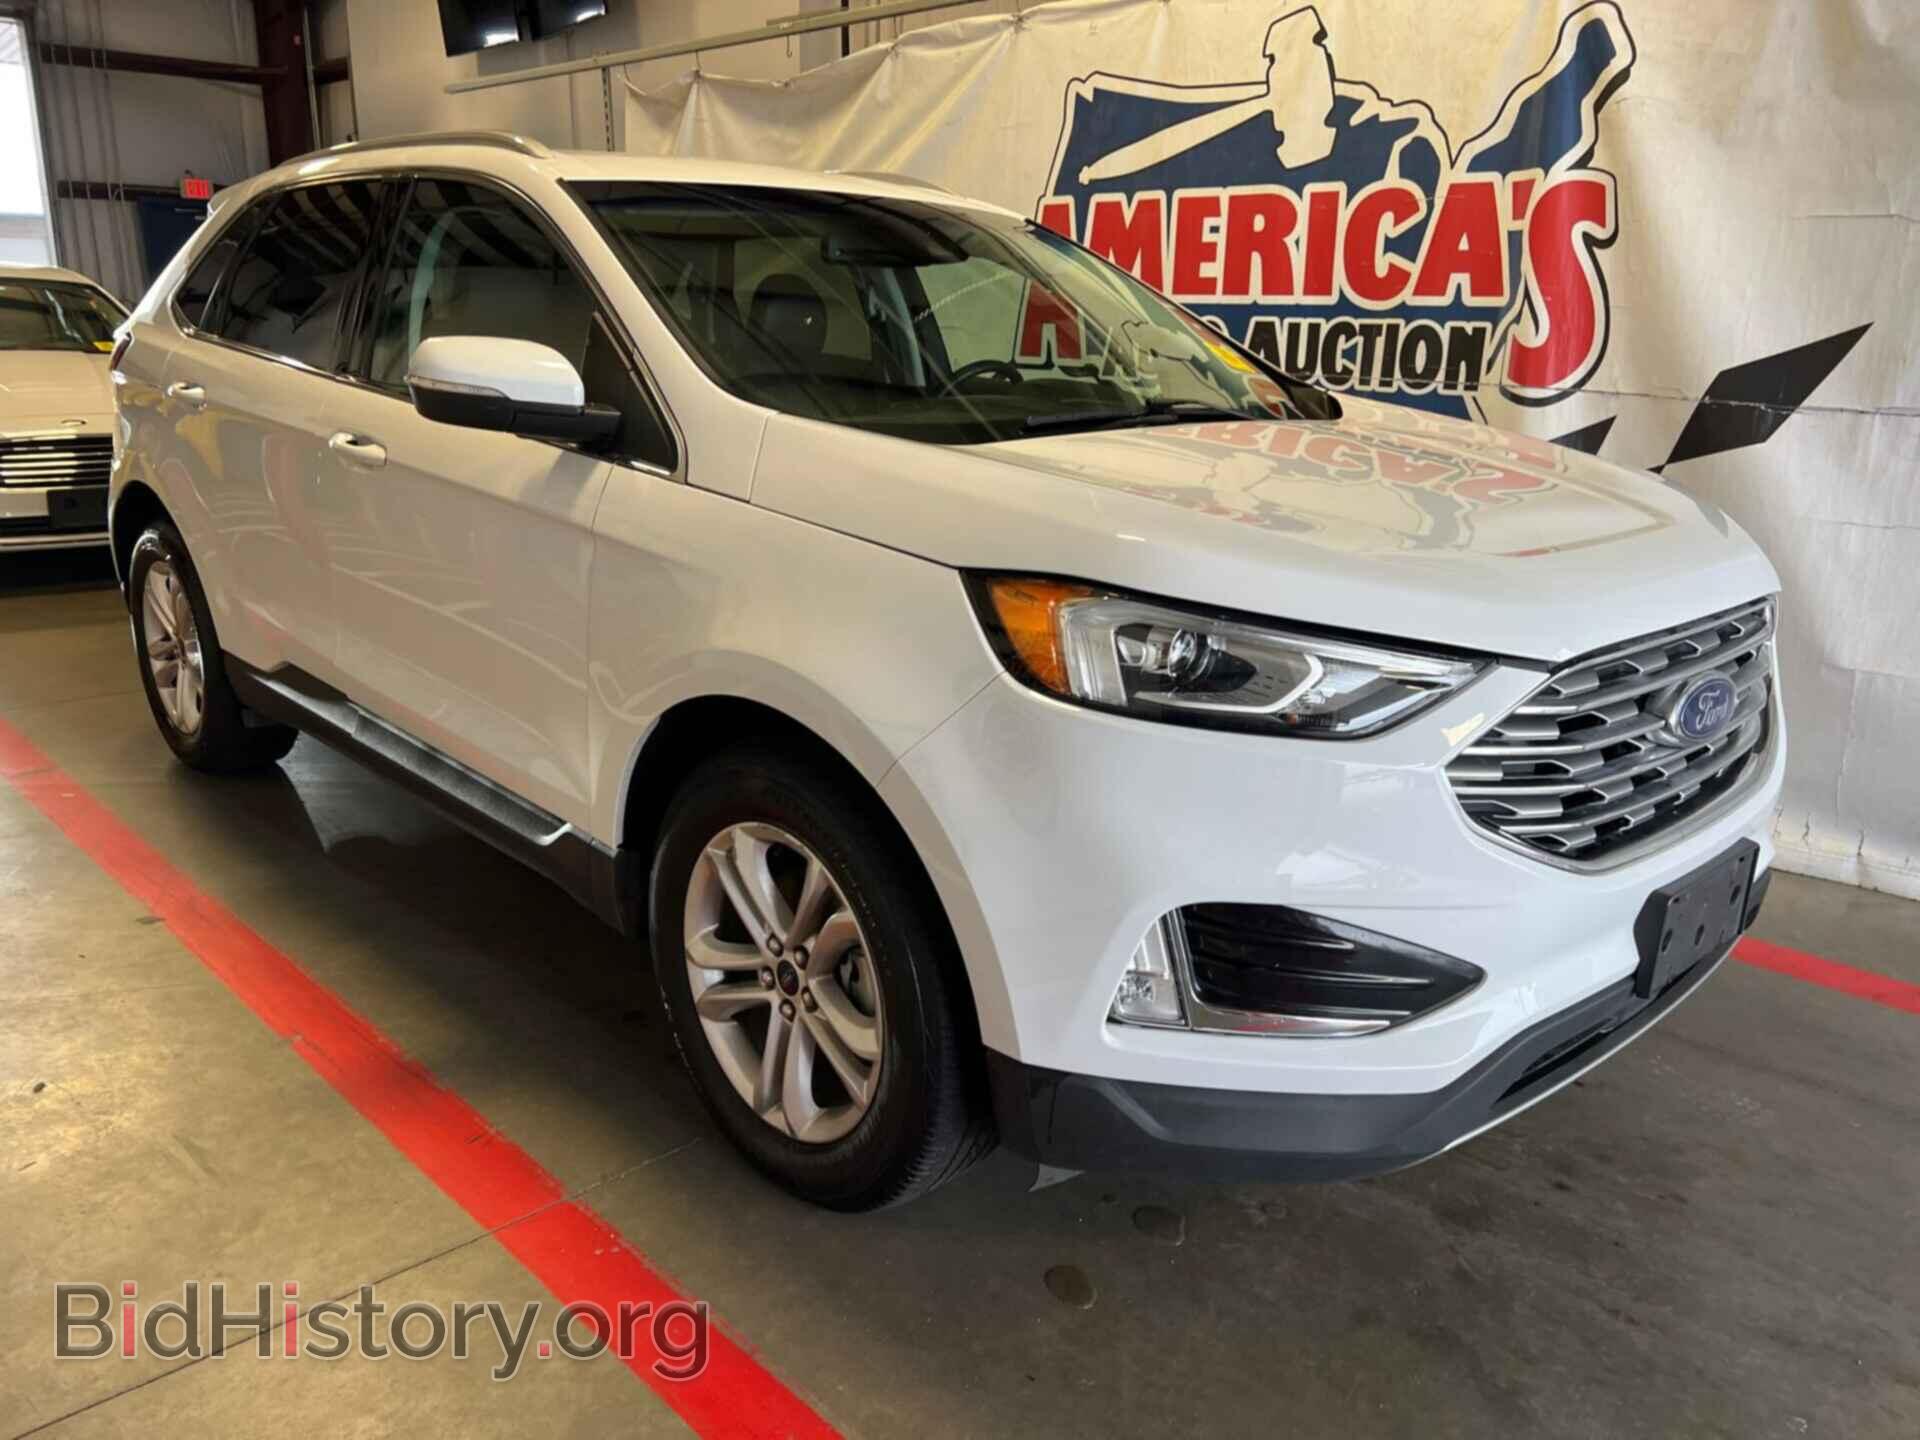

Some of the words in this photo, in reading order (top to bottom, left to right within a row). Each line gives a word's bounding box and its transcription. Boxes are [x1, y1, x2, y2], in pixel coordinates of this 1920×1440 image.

[1020, 178, 1607, 388] AMERICA'S
[1247, 319, 1488, 393] AUCTION
[1695, 689, 1729, 731] Ford
